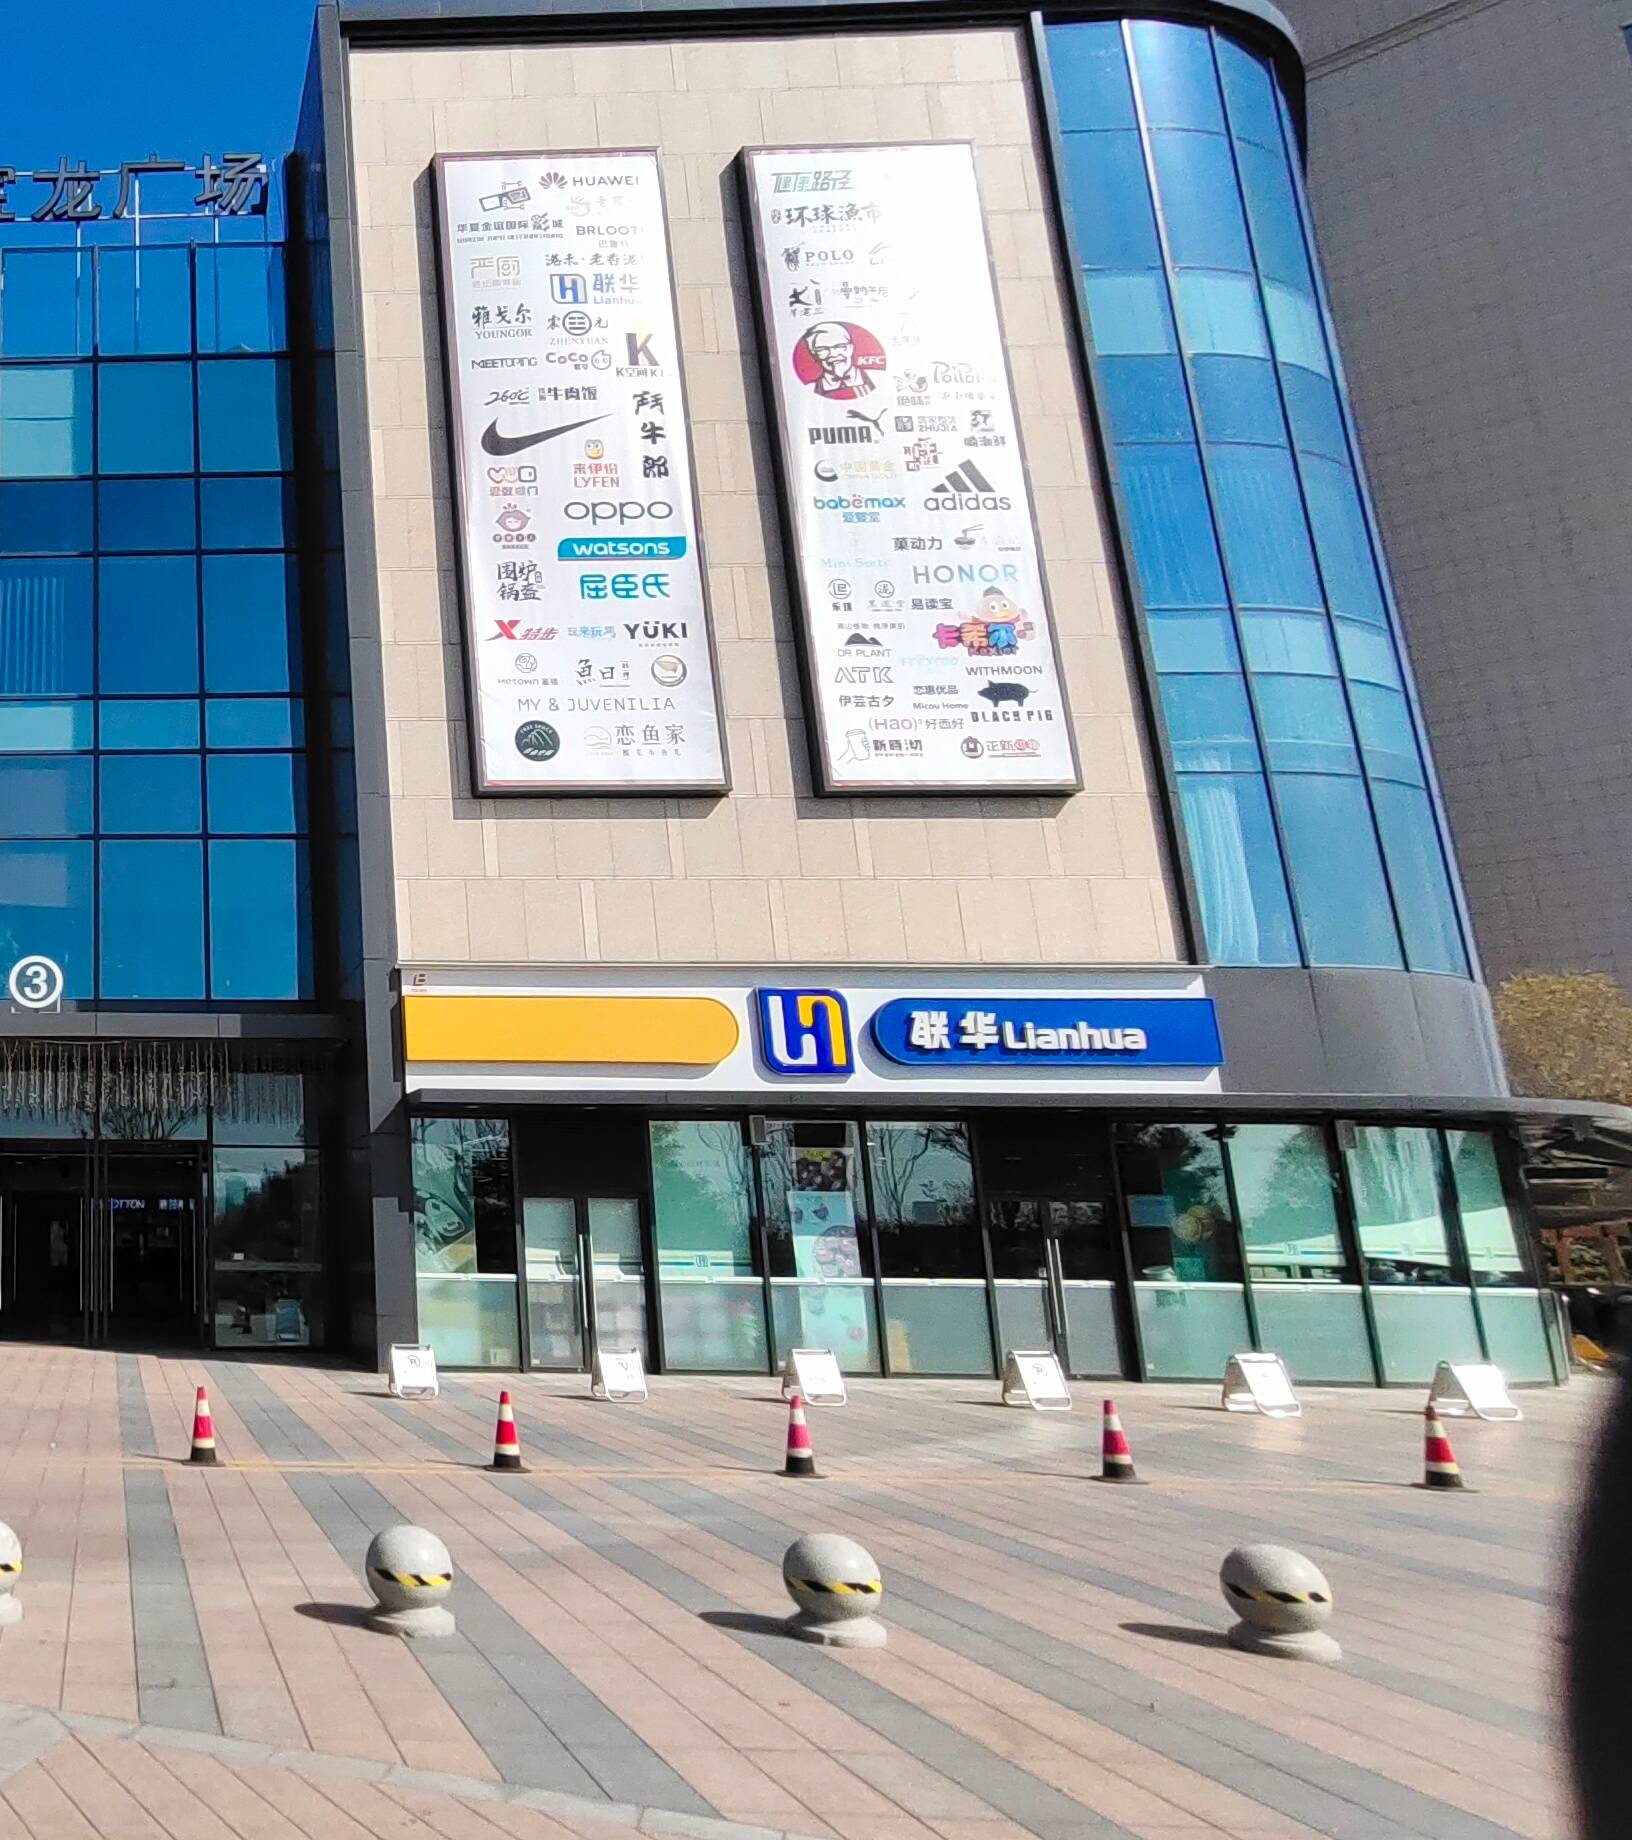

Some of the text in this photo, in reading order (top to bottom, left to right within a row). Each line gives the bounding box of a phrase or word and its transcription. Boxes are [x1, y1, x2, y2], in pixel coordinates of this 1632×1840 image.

[572, 175, 640, 187] HUAWEI
[805, 249, 854, 263] POLO
[593, 272, 640, 293] 联华
[474, 328, 533, 340] YOUNGOR
[857, 355, 885, 366] KFC
[808, 426, 873, 445] PUMA
[572, 463, 619, 475] 来伊份
[573, 476, 620, 488] LYFEN
[924, 493, 1012, 511] adidas
[572, 541, 671, 556] watsons
[912, 564, 1018, 585] HONOR
[579, 573, 671, 600] 屈臣氏
[520, 627, 559, 641] 特步
[965, 665, 1043, 677] WITHMOON
[517, 697, 676, 712] MY & JUVENILIA
[1027, 709, 1054, 722] PIG
[909, 1009, 1148, 1052] 联华 Lianhua
